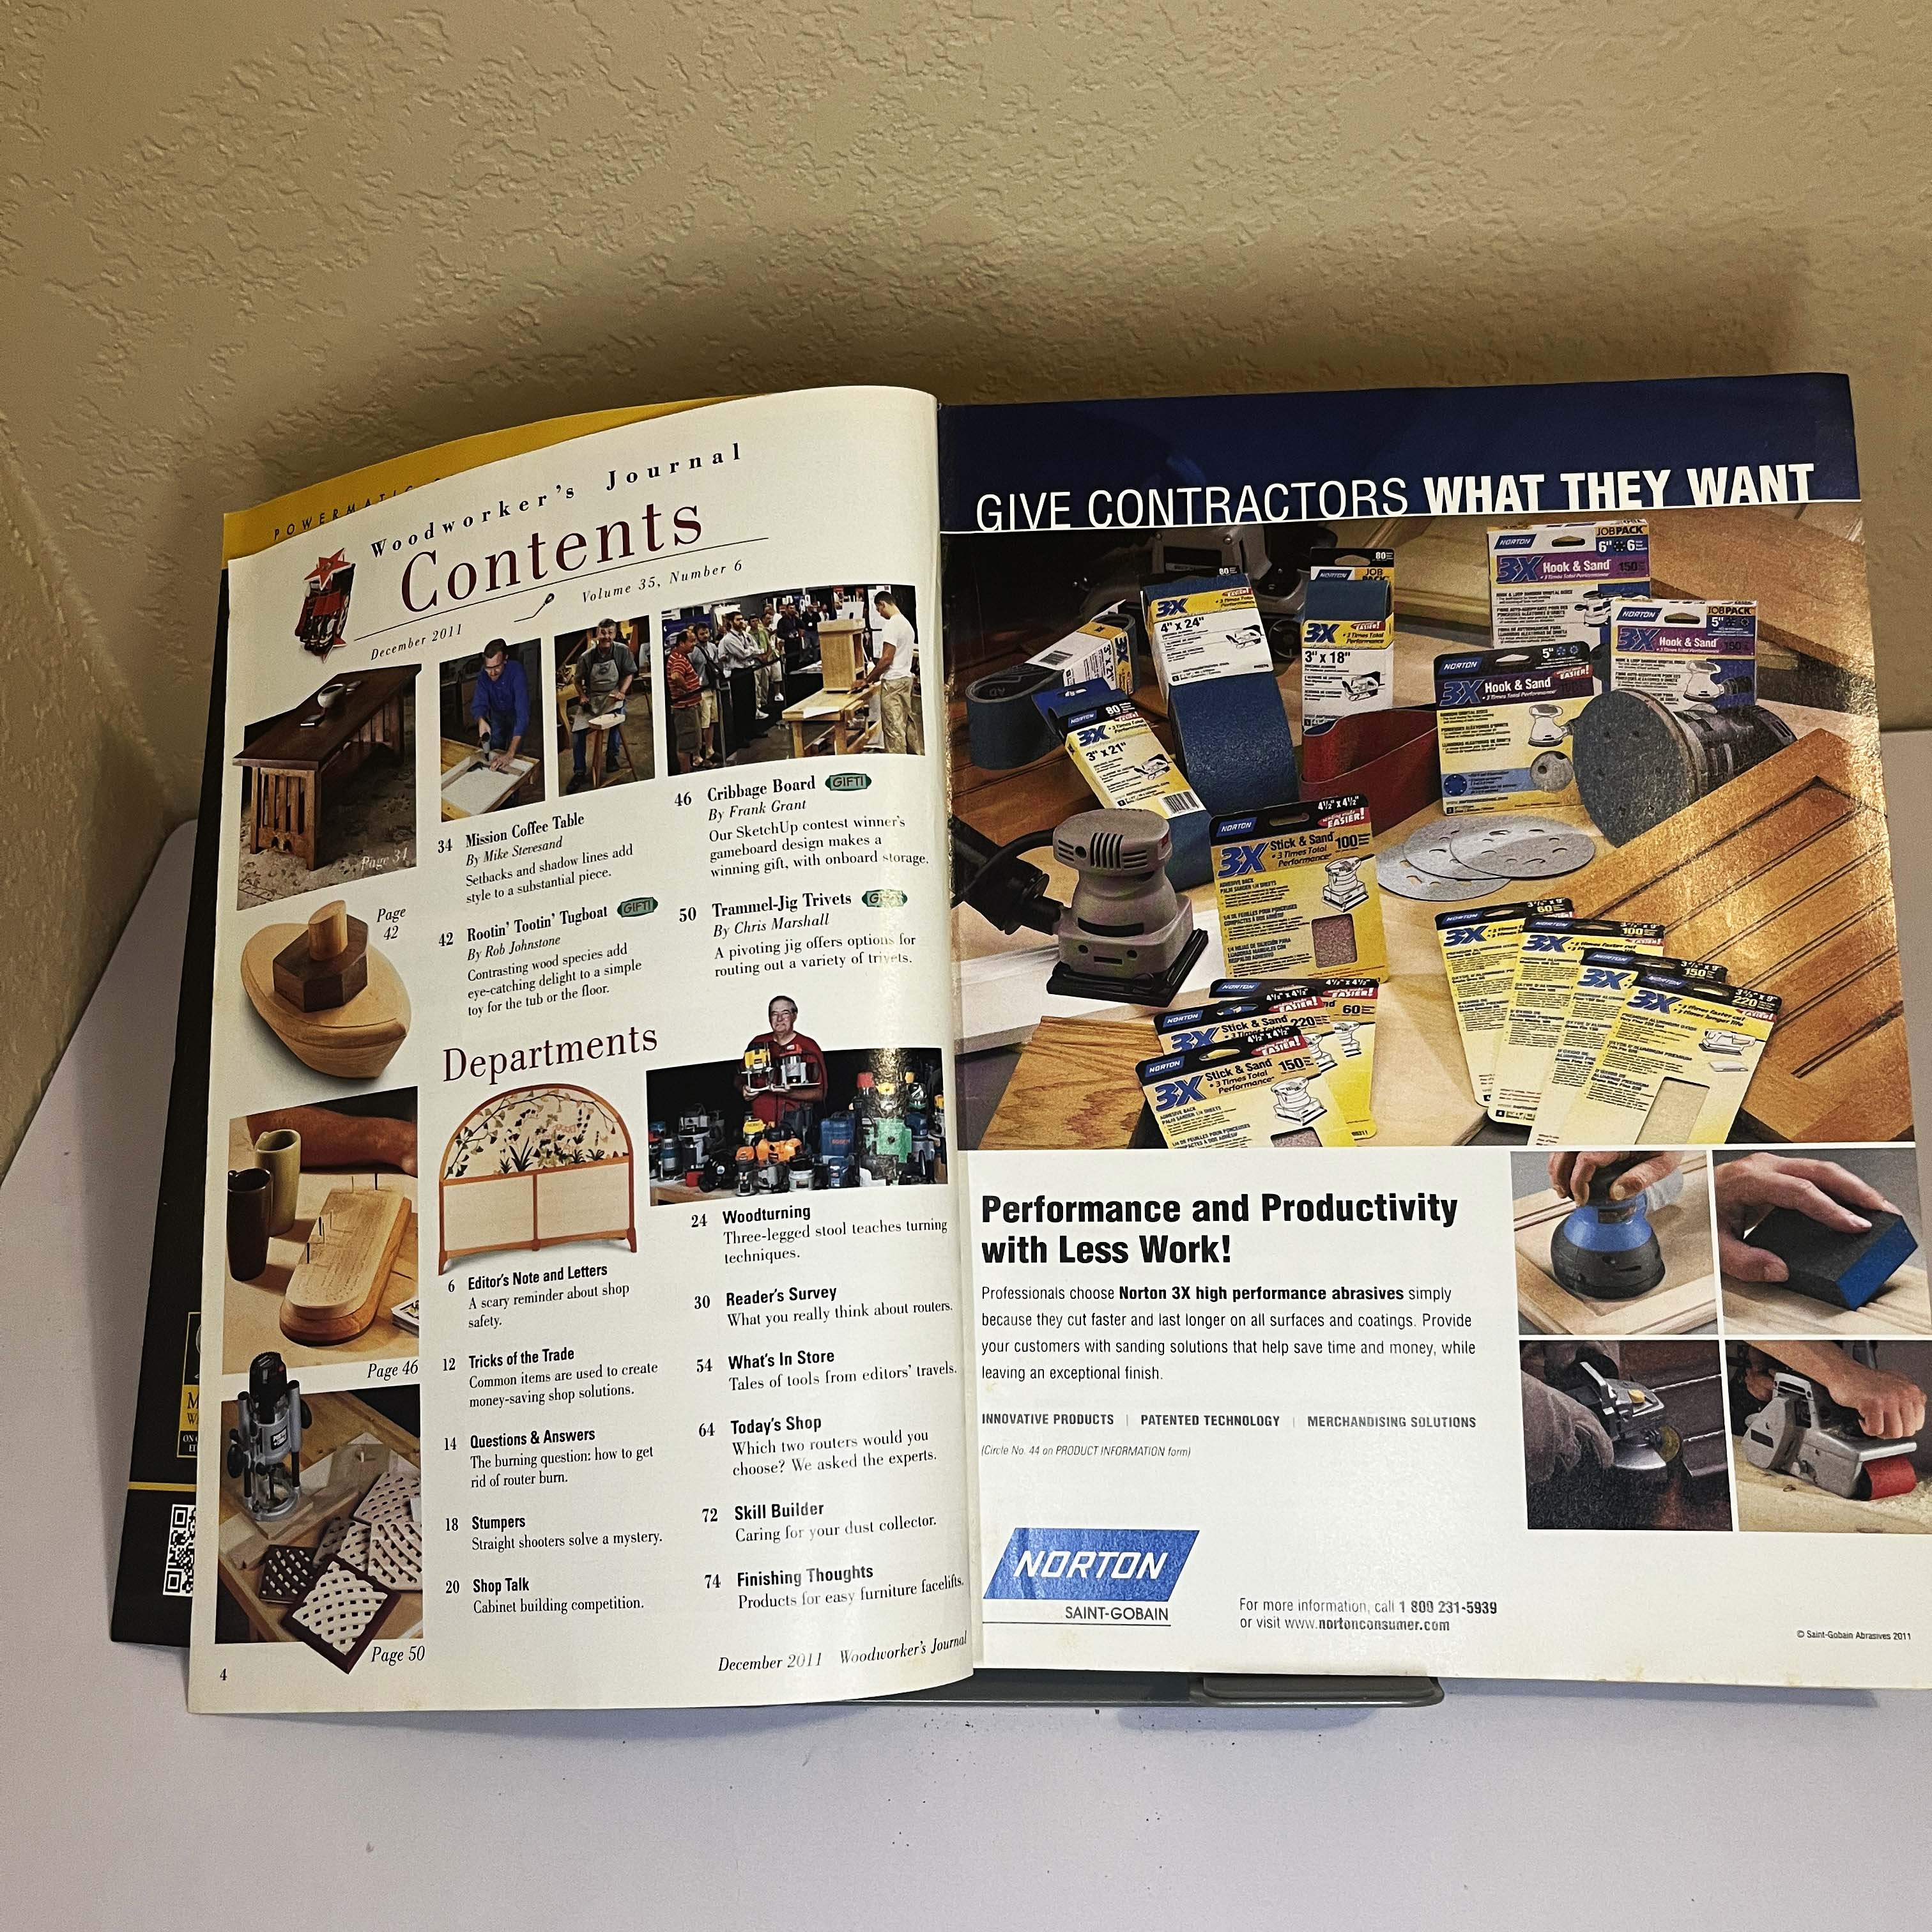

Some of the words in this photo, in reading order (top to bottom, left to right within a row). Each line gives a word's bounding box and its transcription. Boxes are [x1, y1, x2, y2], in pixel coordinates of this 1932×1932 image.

[371, 485, 574, 558] Woodworker's
[606, 443, 740, 491] Journal
[976, 491, 1071, 532] GIVE
[1088, 477, 1408, 528] CONTRACTORS
[1423, 474, 1544, 514] WHAT
[1561, 470, 1670, 510] THEY
[1687, 463, 1814, 505] WANT
[401, 503, 703, 613] Contents
[1543, 561, 1569, 573] Hook
[1572, 561, 1581, 571] &
[1584, 560, 1610, 571] Sand
[1496, 556, 1543, 583] 3X
[583, 586, 631, 602] Volume
[639, 576, 660, 590] 35,
[670, 565, 726, 584] Number
[735, 560, 741, 571] 6
[1156, 597, 1188, 618] 3X
[1161, 623, 1172, 632] 4"
[1175, 622, 1182, 631] x
[1184, 617, 1204, 628] 24"
[1304, 623, 1340, 643] 3X
[371, 638, 426, 660] December
[432, 624, 461, 641] 2011
[1305, 651, 1317, 663] 3"
[1320, 654, 1326, 663] x
[1330, 651, 1350, 663] 18"
[1542, 648, 1554, 659] 5"
[1444, 661, 1477, 670] NORTON
[1560, 665, 1590, 680] EASIER!
[1439, 679, 1485, 707] 3X
[1485, 681, 1512, 693] Hook
[1515, 680, 1522, 691] &
[1526, 678, 1551, 689] Sand
[1106, 705, 1120, 715] 80
[1077, 725, 1110, 747] 3X
[1086, 750, 1098, 762] 3"
[1108, 742, 1126, 755] 21"
[675, 792, 691, 806] 46
[707, 784, 767, 801] Cribbage
[772, 775, 815, 793] Board
[1221, 822, 1252, 832] NORTON
[1328, 807, 1365, 829] EASIER!
[438, 838, 452, 853] 34
[465, 831, 507, 848] Mission
[512, 821, 548, 838] Coffee
[552, 812, 584, 829] Table
[1270, 838, 1296, 851] Stick
[1298, 836, 1307, 847] &
[1310, 832, 1333, 845] Sand
[1335, 834, 1358, 849] 100
[361, 856, 389, 870] Page
[466, 868, 512, 886] Setbacks
[517, 862, 535, 877] and
[539, 856, 578, 872] shadow
[582, 852, 608, 864] lines
[613, 843, 632, 858] add
[1218, 842, 1269, 878] 3X
[377, 908, 406, 923] Page
[679, 907, 696, 922] 50
[712, 896, 797, 917] Trammel-Jig
[802, 893, 851, 907] Trivets
[384, 926, 398, 940] 42
[439, 932, 454, 946] 42
[467, 921, 509, 942] Rootin'
[514, 913, 555, 933] Tootin'
[560, 907, 607, 926] Tugboat
[1443, 926, 1489, 947] 3X
[1577, 968, 1630, 990] 3X
[1342, 1004, 1360, 1015] 60
[1627, 990, 1682, 1014] 3X
[1732, 996, 1758, 1007] 220
[443, 1027, 657, 1085] Departments
[1262, 1036, 1301, 1057] EASIER!
[1149, 1060, 1181, 1073] NORTON
[1205, 1068, 1232, 1082] Stick
[1235, 1064, 1245, 1075] &
[1246, 1059, 1273, 1073] Sand
[1278, 1057, 1305, 1071] 150
[1155, 1075, 1208, 1112] 3X
[691, 1214, 707, 1227] 24
[723, 1205, 810, 1224] Woodturning
[983, 1195, 1180, 1223] Performance
[1193, 1194, 1248, 1222] and
[1262, 1193, 1457, 1227] Productivity
[982, 1236, 1046, 1263] with
[1060, 1236, 1128, 1263] Less
[1139, 1235, 1230, 1263] Work!
[448, 1280, 455, 1292] 6
[468, 1273, 509, 1290] Editor's
[513, 1272, 539, 1285] Note
[544, 1267, 564, 1282] and
[568, 1266, 607, 1279] Letters
[694, 1295, 710, 1309] 30
[726, 1289, 784, 1307] Reader's
[789, 1287, 836, 1301] Survey
[468, 1314, 502, 1329] safety.
[443, 1358, 456, 1371] 12
[469, 1354, 503, 1368] Tricks
[507, 1351, 518, 1365] of
[521, 1351, 539, 1364] the
[542, 1347, 574, 1361] Trade
[697, 1358, 712, 1372] 54
[728, 1353, 774, 1369] What's
[780, 1353, 792, 1365] In
[798, 1351, 834, 1364] Store
[367, 1363, 398, 1381] Page
[402, 1360, 418, 1374] 46
[699, 1423, 715, 1437] 64
[730, 1418, 781, 1436] Today's
[786, 1416, 821, 1432] Shop
[983, 1413, 1048, 1424] INNOVATIVE
[1054, 1414, 1114, 1425] PRODUCTS
[1141, 1414, 1199, 1425] PATENTED
[1204, 1415, 1280, 1426] TECHNOLOGY
[1308, 1416, 1406, 1427] MERCHANDISING
[1411, 1416, 1476, 1428] SOLUTIONS
[445, 1437, 456, 1450] 14
[471, 1433, 526, 1448] Questions
[530, 1430, 540, 1444] &
[543, 1430, 595, 1443] Answers
[702, 1508, 717, 1522] 72
[735, 1505, 765, 1520] Skill
[772, 1502, 824, 1518] Builder
[446, 1518, 458, 1531] 18
[472, 1516, 525, 1532] Stumpers
[1013, 1549, 1169, 1580] NORTON
[446, 1580, 459, 1593] 20
[473, 1579, 502, 1595] Shop
[505, 1577, 529, 1591] Talk
[705, 1574, 721, 1588] 74
[738, 1570, 801, 1587] Finishing
[806, 1565, 873, 1583] Thoughts
[1066, 1606, 1168, 1620] SAINT-GOBAIN
[1240, 1598, 1259, 1611] For
[1263, 1601, 1293, 1611] more
[1375, 1600, 1394, 1613] call
[1399, 1600, 1404, 1613] 1
[1411, 1600, 1434, 1613] 800
[1438, 1601, 1497, 1614] 231-5939
[1241, 1618, 1252, 1628] or
[1257, 1616, 1281, 1629] visit
[1285, 1617, 1450, 1630] www.nortonconsumer.com
[1807, 1630, 1853, 1639] Saint-Gobain
[371, 1646, 404, 1666] Page
[409, 1646, 425, 1660] 50
[718, 1655, 783, 1671] December
[787, 1653, 821, 1667] 2011
[841, 1641, 926, 1664] Woodworker's
[931, 1628, 967, 1654] Journal
[219, 1668, 227, 1681] 4
